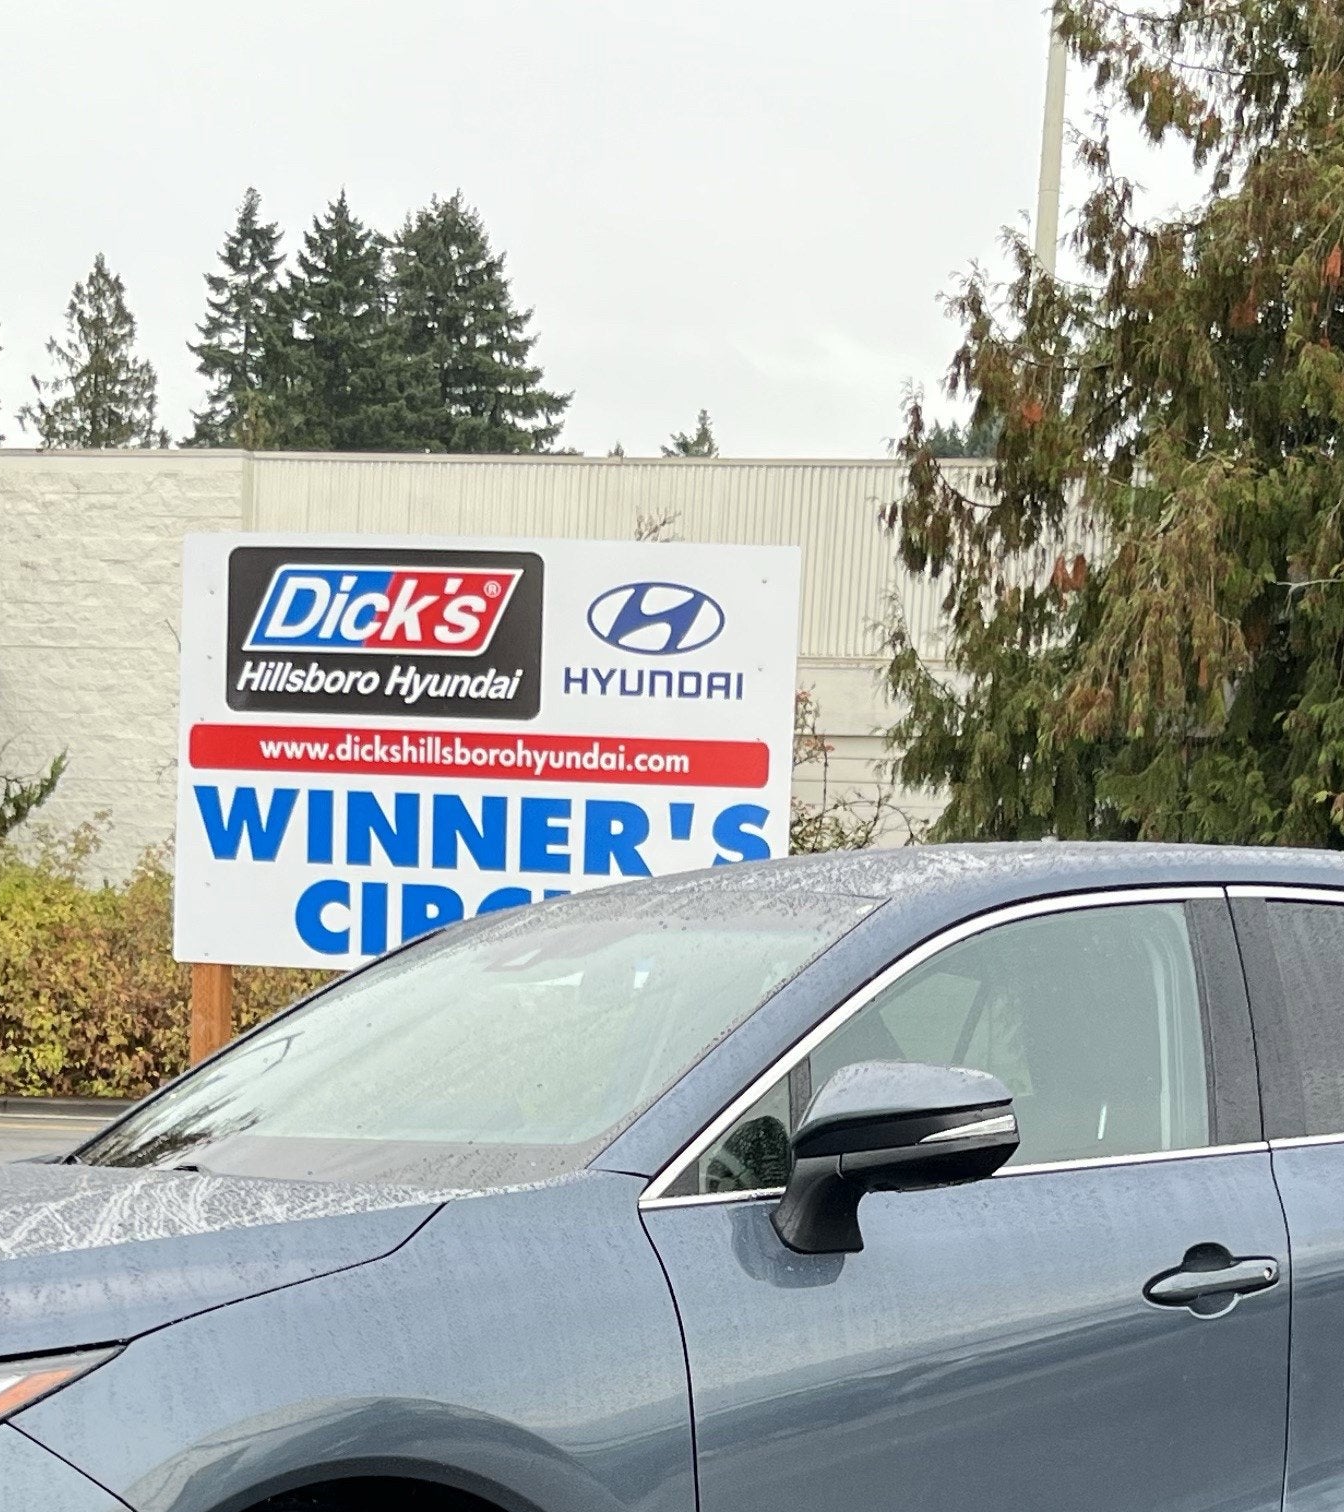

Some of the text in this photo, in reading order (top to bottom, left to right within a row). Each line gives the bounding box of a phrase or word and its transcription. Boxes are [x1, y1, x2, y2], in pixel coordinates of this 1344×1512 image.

[264, 575, 487, 644] Dick's
[236, 661, 524, 704] Hillsboro Hyundai
[563, 666, 744, 700] HYUNDAI
[259, 734, 690, 776] www.dickshillsborohyundai.com
[193, 785, 772, 877] WINNER'S
[295, 879, 573, 955] CIR
